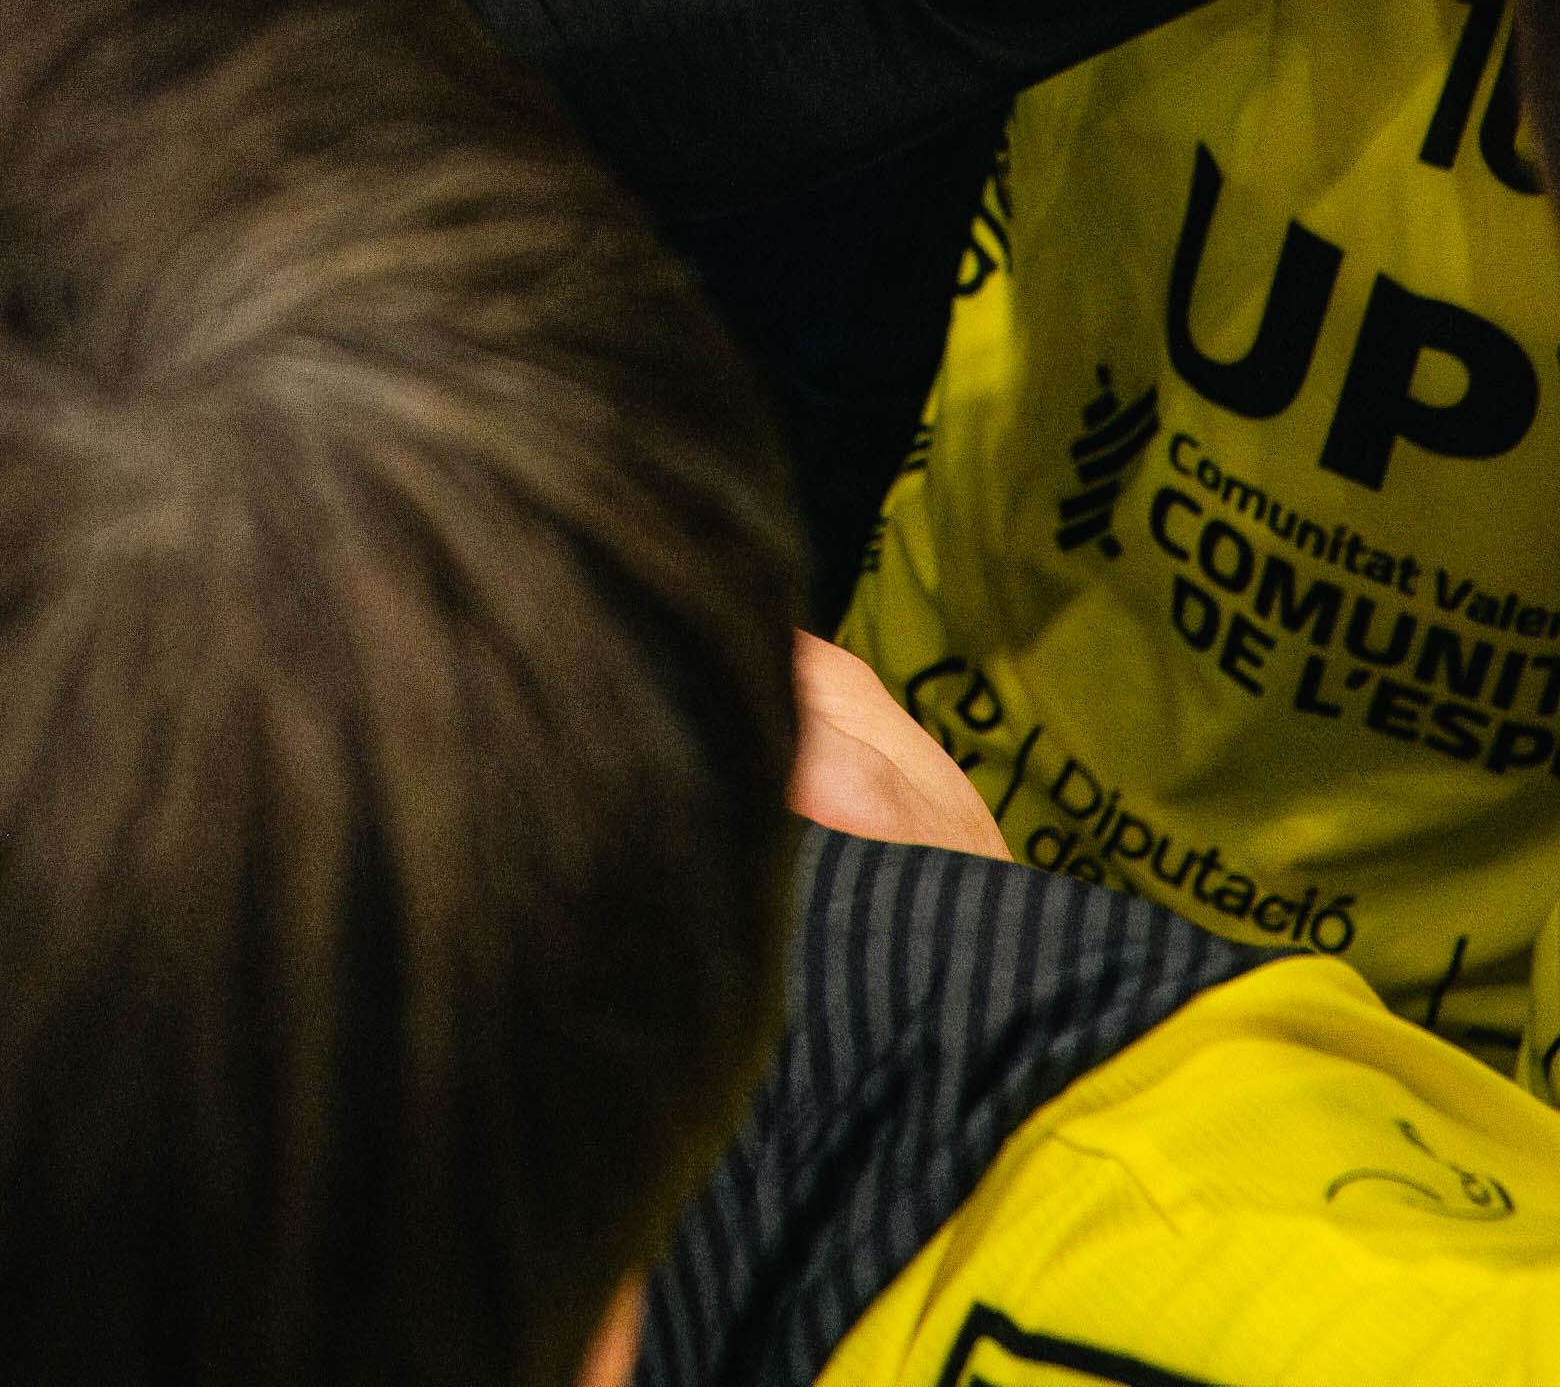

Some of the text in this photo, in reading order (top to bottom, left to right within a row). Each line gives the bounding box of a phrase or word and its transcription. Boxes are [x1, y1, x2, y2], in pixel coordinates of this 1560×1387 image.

[1168, 432, 1422, 597] Comunitat
[1171, 572, 1277, 698] DE
[1050, 758, 1355, 955] Diputació
